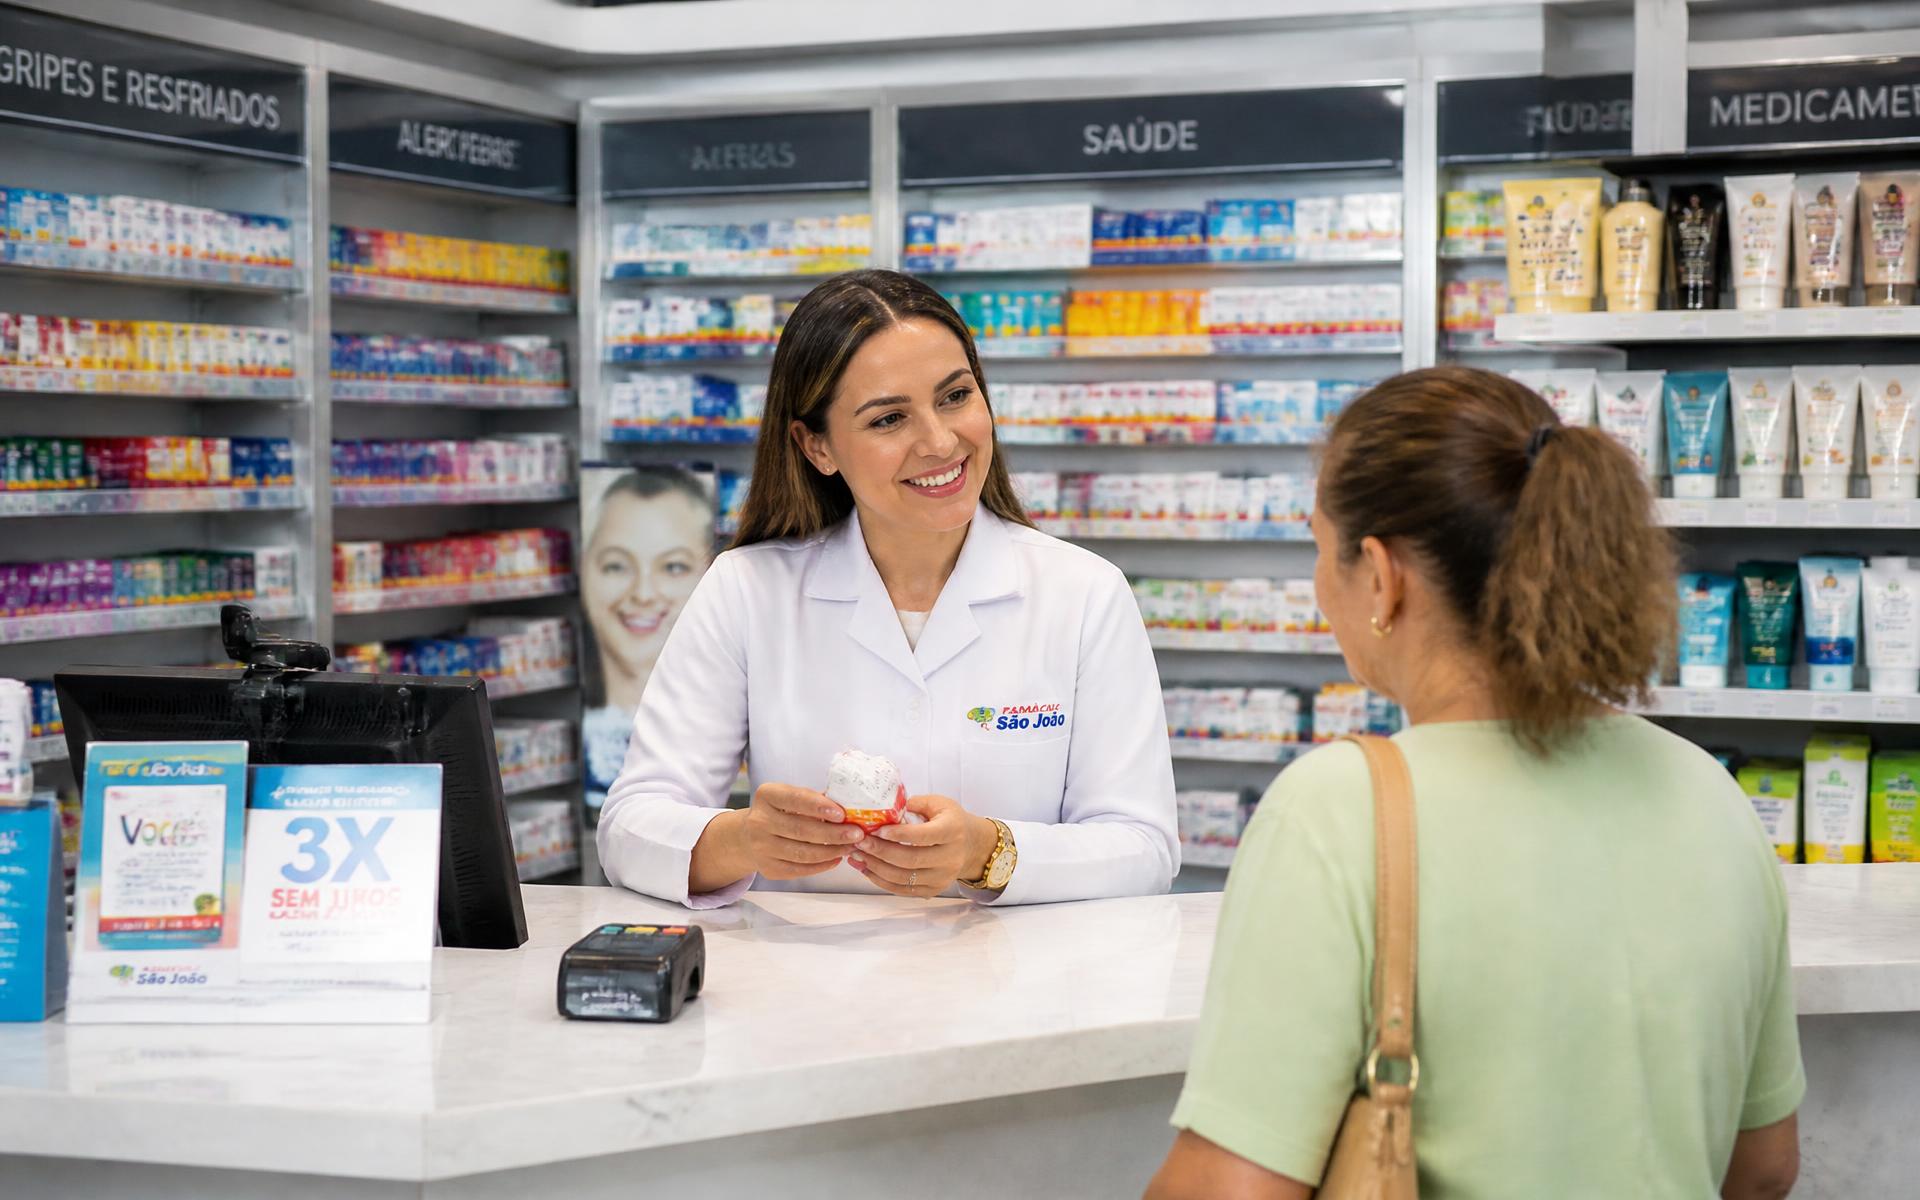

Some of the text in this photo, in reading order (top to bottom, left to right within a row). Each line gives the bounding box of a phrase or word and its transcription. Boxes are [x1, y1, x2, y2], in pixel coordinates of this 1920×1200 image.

[0, 45, 281, 130] GRIPES E RESFRIADOS
[1082, 115, 1199, 155] SAÚDE
[996, 711, 1065, 730] São João
[280, 817, 395, 884] 3X
[271, 887, 320, 908] SEM
